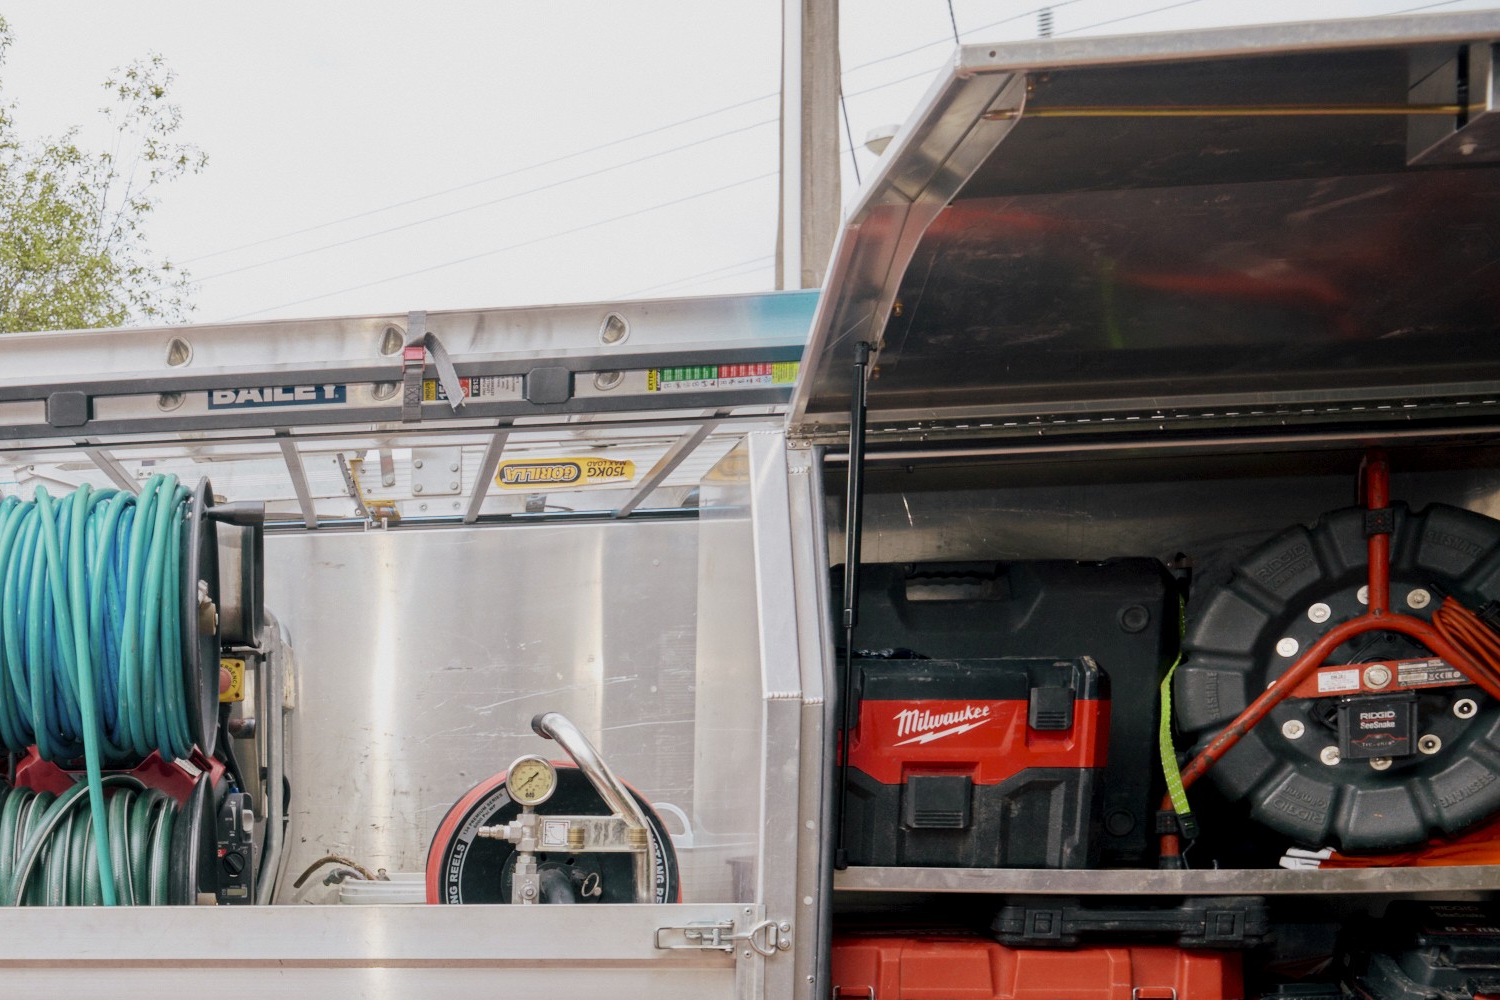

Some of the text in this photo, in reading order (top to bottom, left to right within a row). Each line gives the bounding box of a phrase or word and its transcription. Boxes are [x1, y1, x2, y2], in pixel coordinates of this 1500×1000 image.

[219, 385, 336, 405] BAILEY
[505, 465, 577, 482] GORILLA
[587, 465, 626, 478] 150KG
[893, 705, 990, 737] Milwaukee
[1359, 710, 1396, 720] RIDGID
[1359, 720, 1396, 730] SeeSnake
[469, 806, 487, 827] PREMIUM
[487, 793, 503, 806] SERIES
[1274, 799, 1326, 825] RIDGID
[449, 843, 466, 882] REELS
